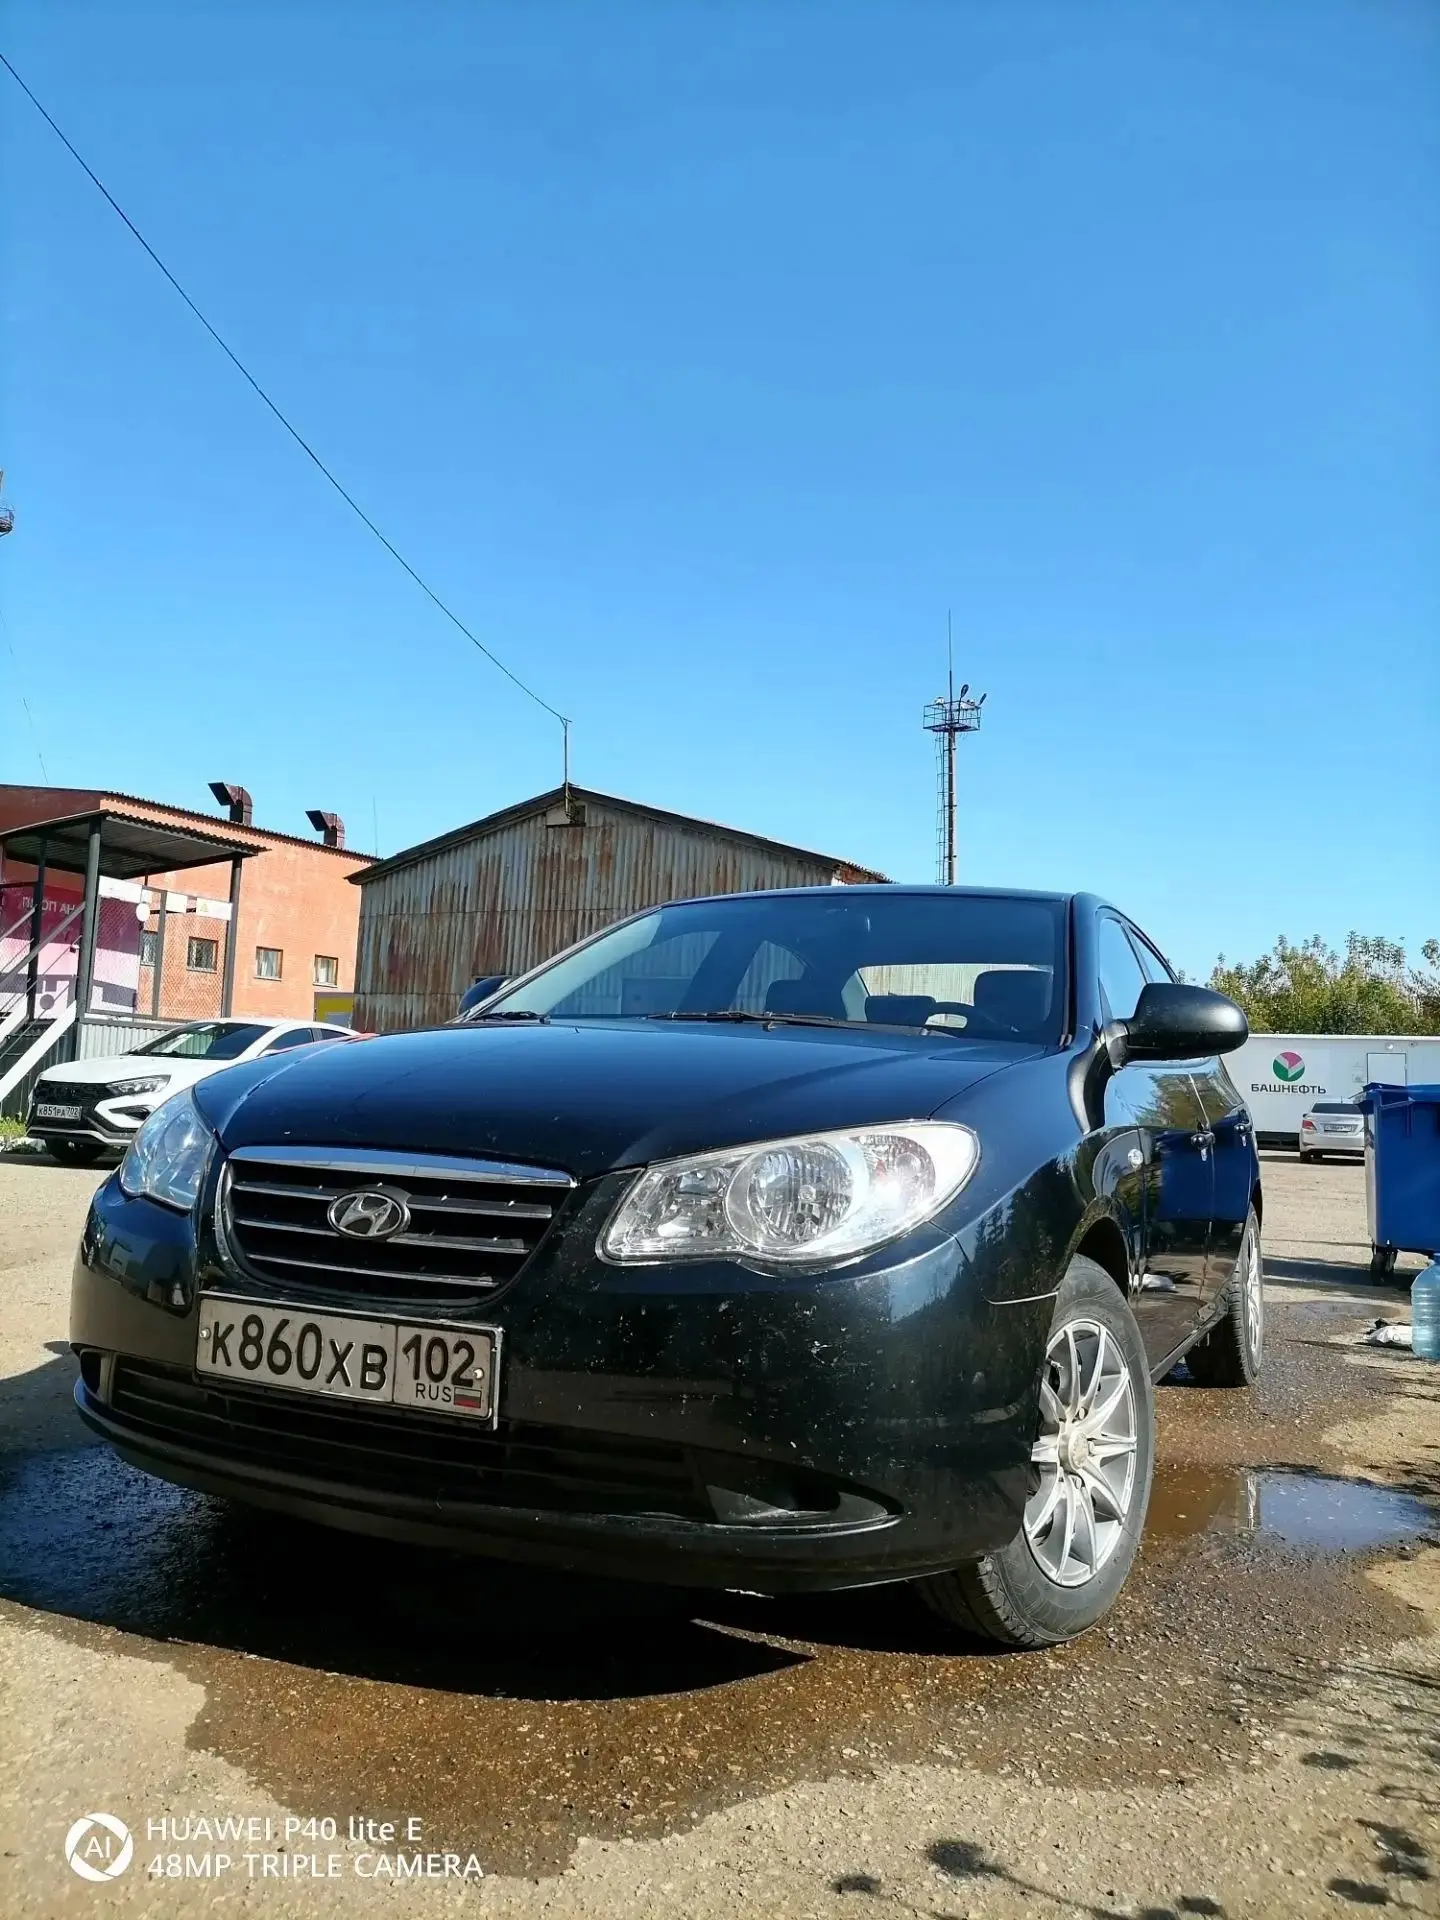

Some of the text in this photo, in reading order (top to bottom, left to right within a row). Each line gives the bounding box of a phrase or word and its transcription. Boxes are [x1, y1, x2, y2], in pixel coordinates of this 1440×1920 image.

[22, 895, 76, 914] ПОПАН
[1251, 1083, 1327, 1095] БАШНЕФТЬ
[210, 1314, 475, 1391] К860ХВ 102
[415, 1382, 451, 1402] RUS
